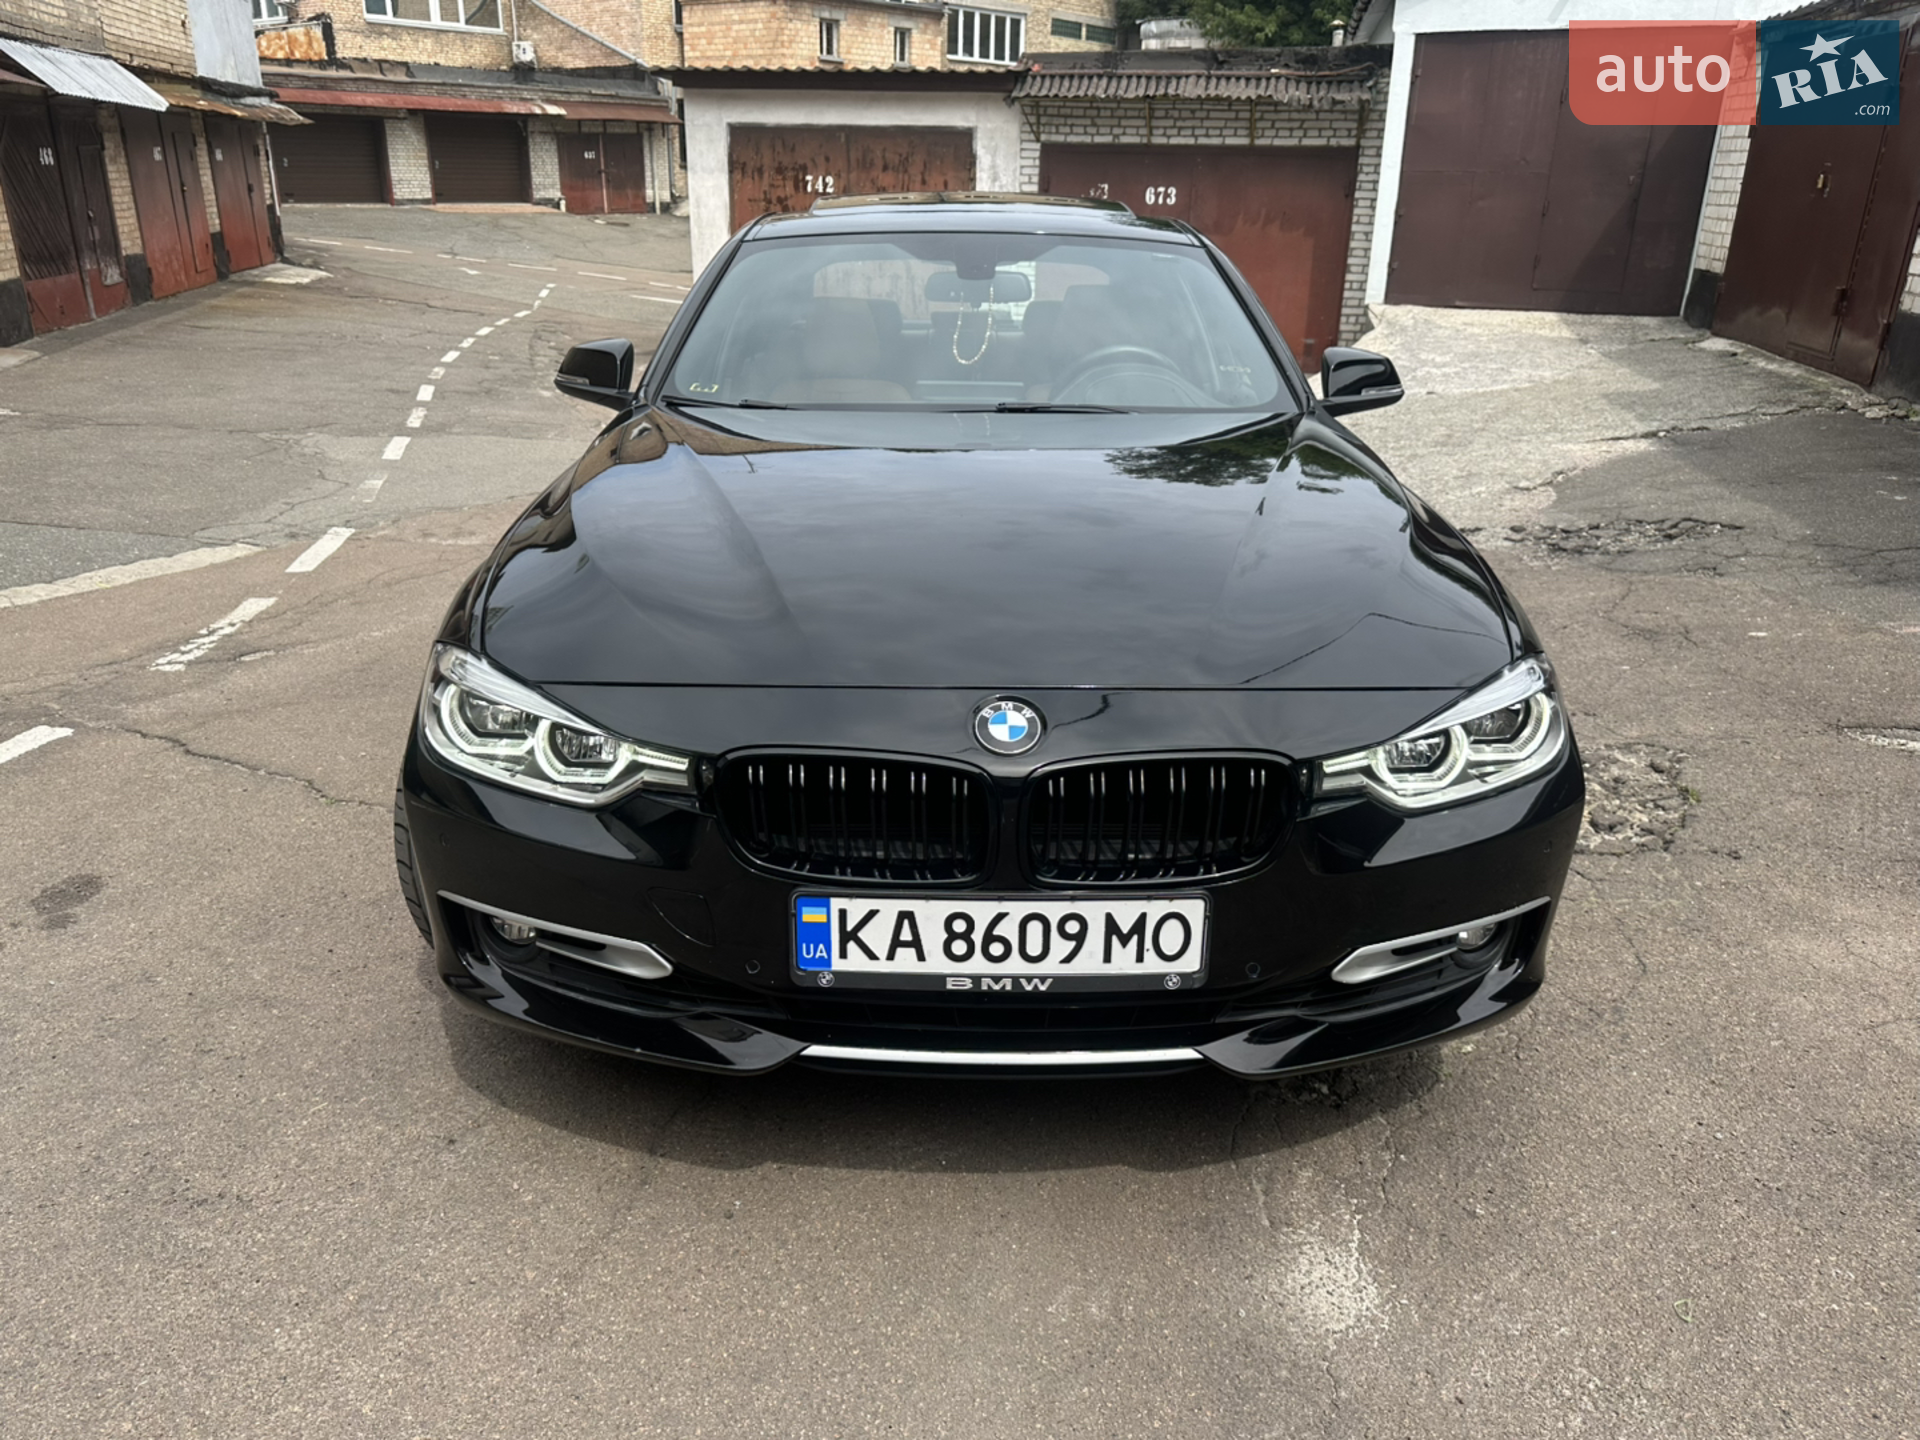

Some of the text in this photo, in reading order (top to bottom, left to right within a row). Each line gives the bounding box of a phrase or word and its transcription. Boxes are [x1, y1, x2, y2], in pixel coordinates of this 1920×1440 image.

[805, 175, 834, 193] 742
[1145, 186, 1176, 205] 673
[981, 702, 1035, 718] BMW
[838, 908, 1191, 964] KA 8609 MO
[802, 943, 828, 959] UA
[946, 977, 1053, 991] BMW
